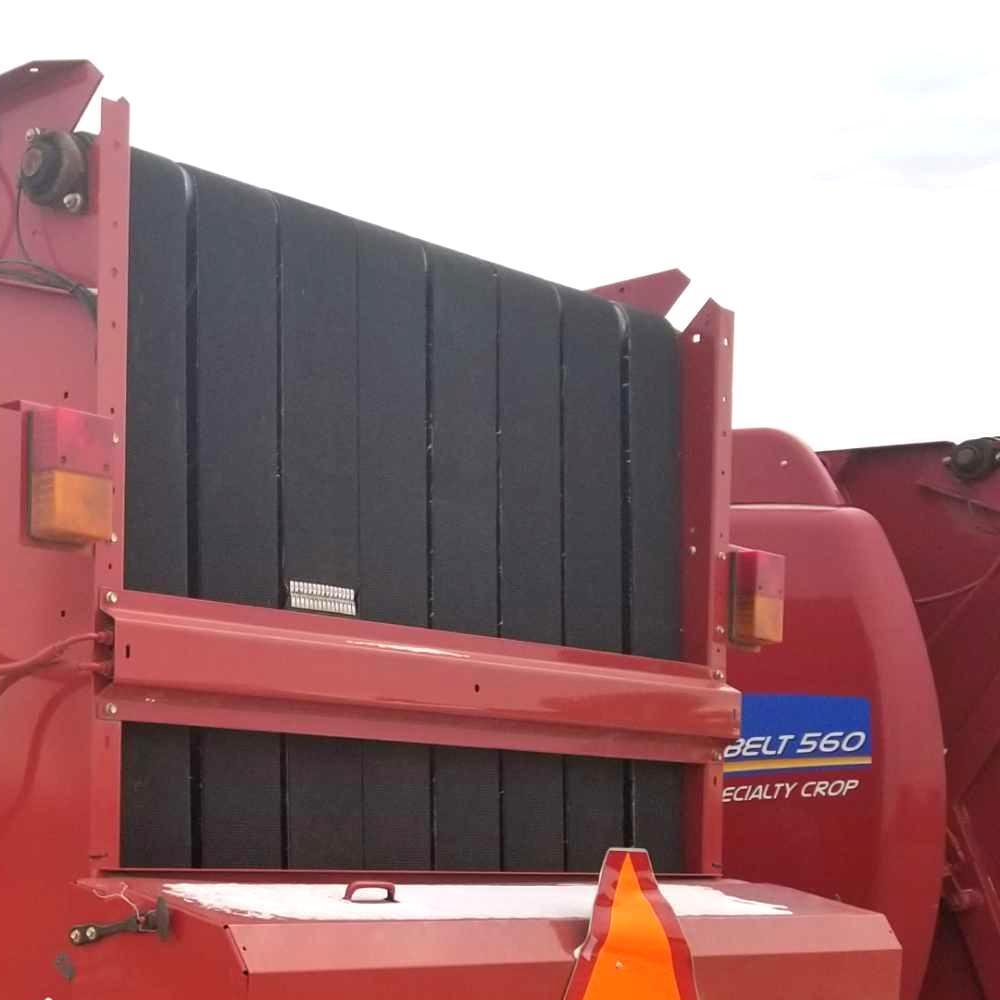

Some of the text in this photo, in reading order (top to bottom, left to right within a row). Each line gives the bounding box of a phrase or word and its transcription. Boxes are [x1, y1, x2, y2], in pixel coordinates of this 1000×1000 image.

[723, 731, 865, 758] BELT 560
[722, 779, 860, 803] ECIALTY CROP
